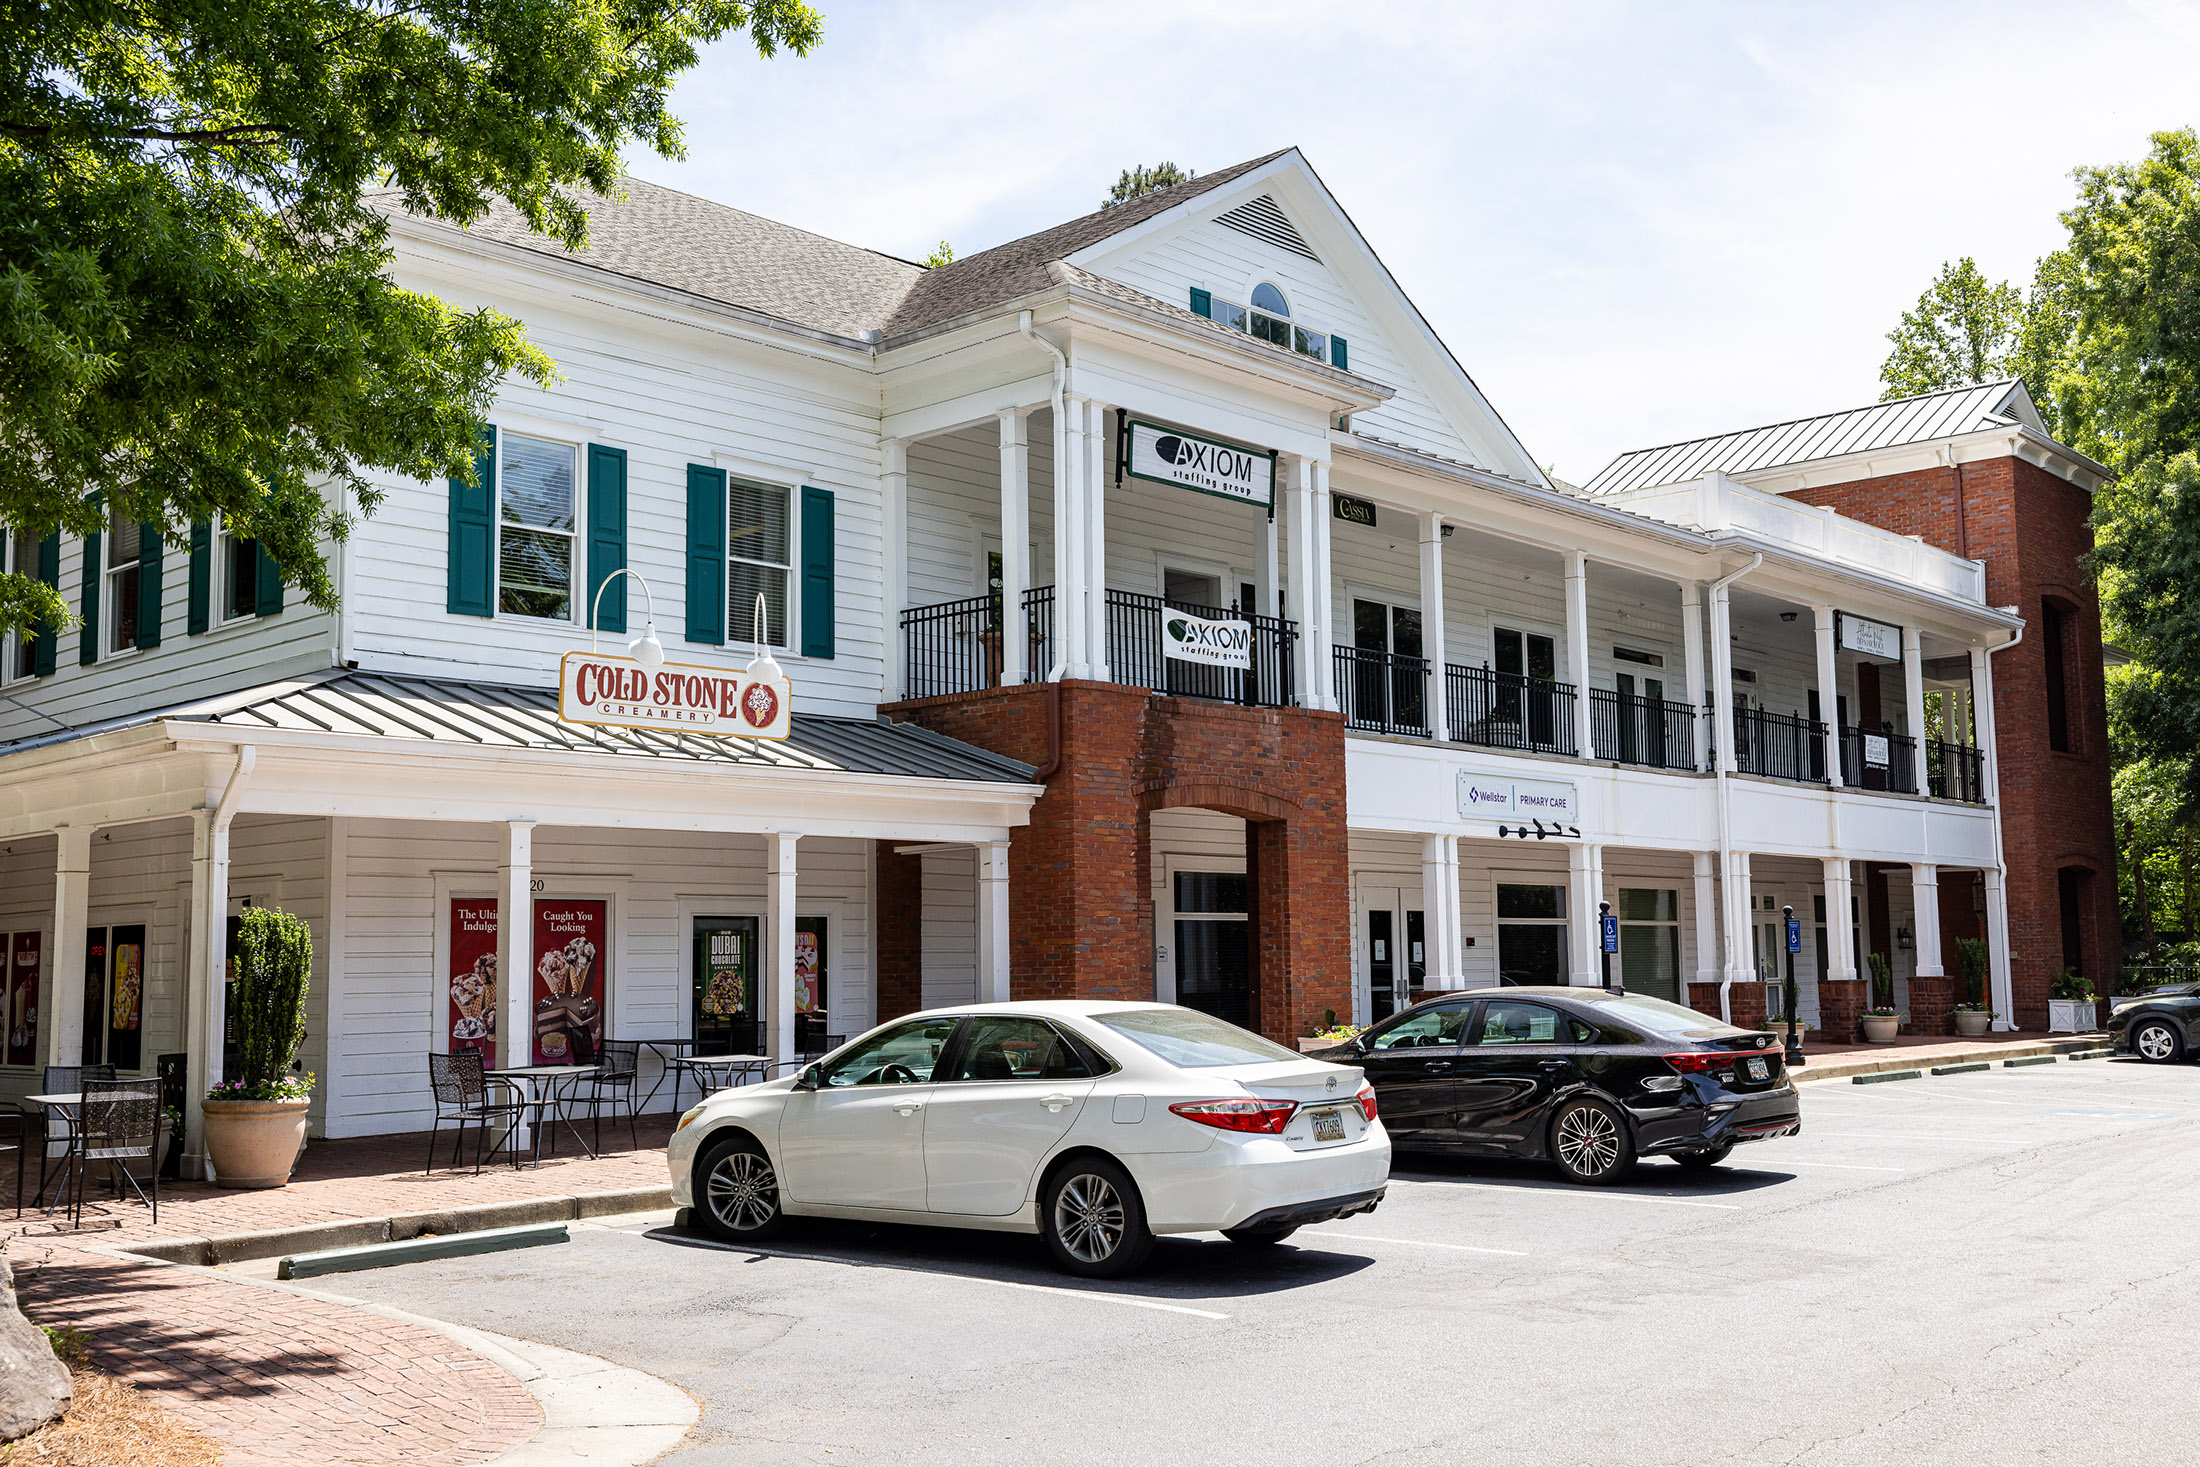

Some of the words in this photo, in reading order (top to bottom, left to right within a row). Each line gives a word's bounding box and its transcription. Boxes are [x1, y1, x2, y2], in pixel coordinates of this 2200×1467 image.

[1174, 438, 1252, 482] AXIOM
[1173, 470, 1217, 488] staffing
[1223, 482, 1251, 496] group
[1181, 622, 1249, 650] AXIOM
[1181, 646, 1219, 659] staffing
[576, 663, 648, 706] COLD
[653, 672, 738, 719] STONE
[603, 704, 710, 722] CREAMERY
[1480, 791, 1507, 803] Wellstar
[1520, 795, 1548, 807] PRIMARY
[1549, 798, 1567, 809] CARE
[458, 909, 477, 919] The
[543, 910, 574, 923] Caught
[576, 911, 593, 921] You
[550, 922, 586, 934] Looking
[711, 935, 741, 955] DUBAI
[711, 954, 741, 965] CHOCOLATE
